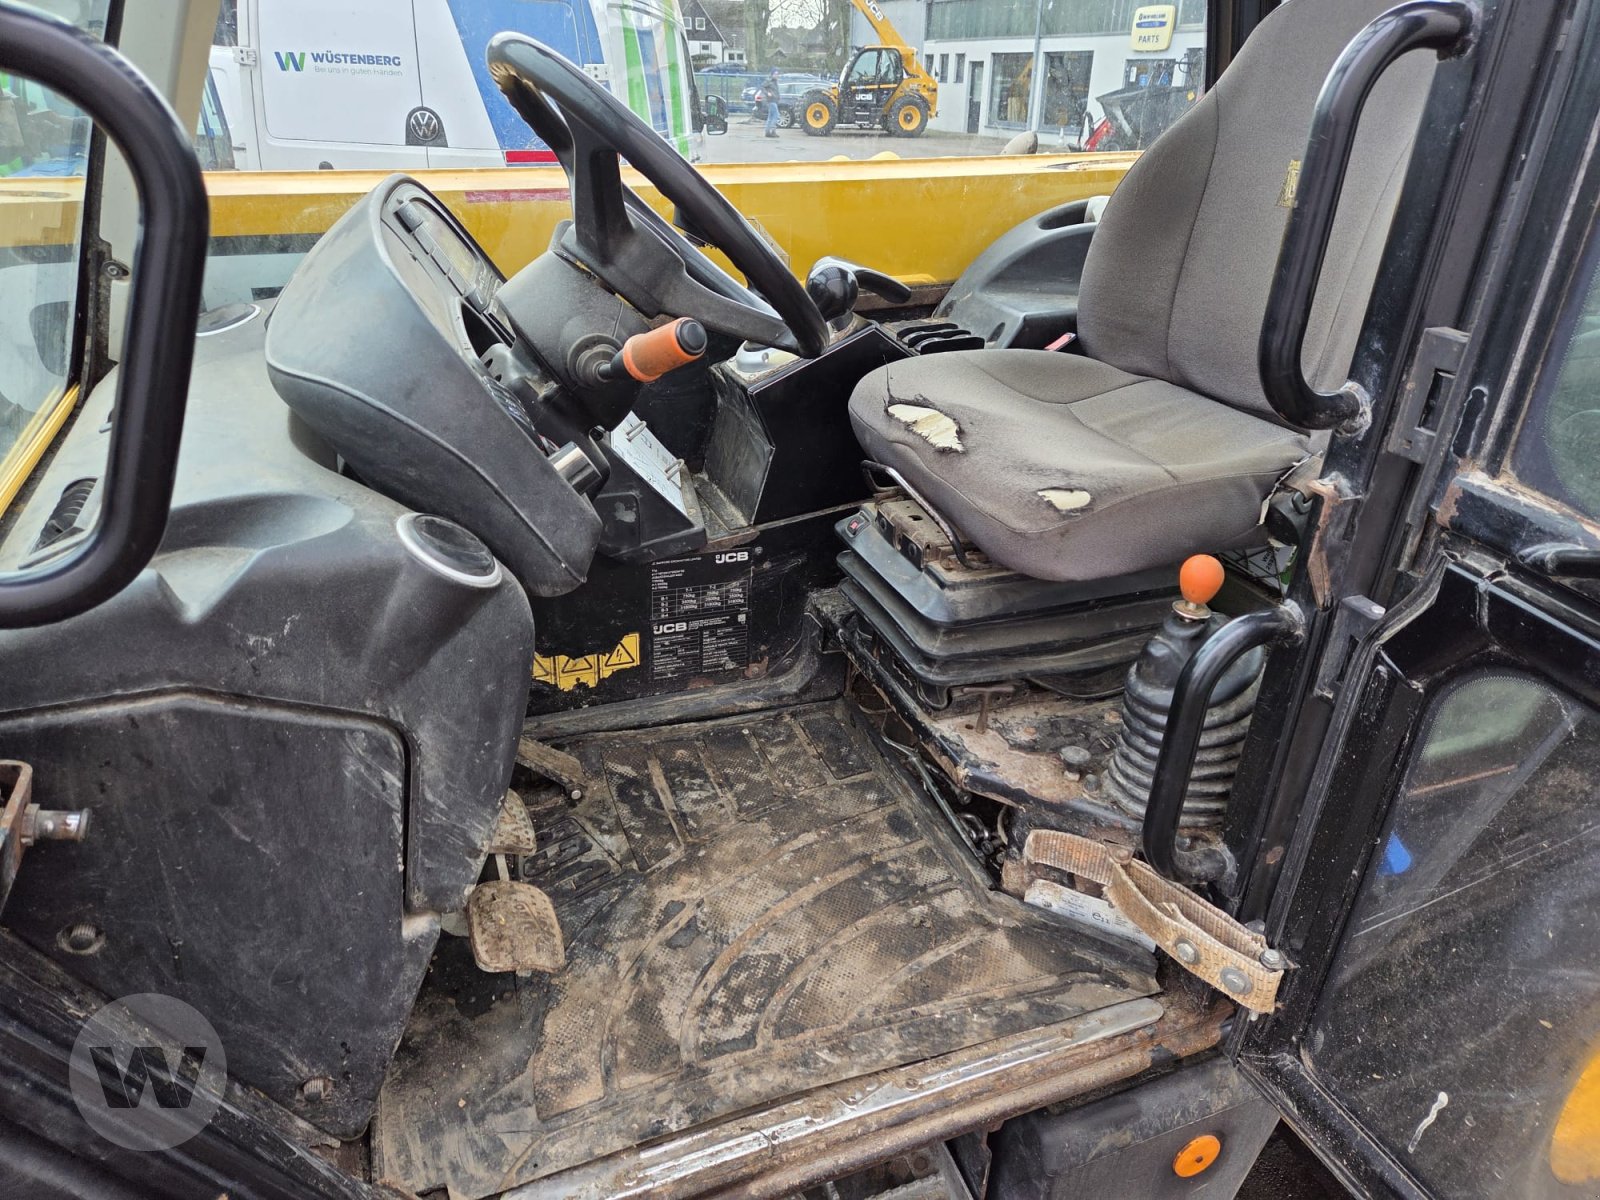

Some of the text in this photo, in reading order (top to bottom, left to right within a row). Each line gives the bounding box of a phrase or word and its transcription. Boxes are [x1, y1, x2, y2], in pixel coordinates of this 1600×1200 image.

[1138, 35, 1159, 43] PARTS
[310, 50, 401, 66] WÜSTENBERG
[314, 65, 327, 73] Bei
[328, 66, 340, 74] uns
[341, 66, 349, 74] in
[350, 67, 371, 76] guten
[715, 551, 749, 564] JCB
[653, 622, 687, 635] JCB
